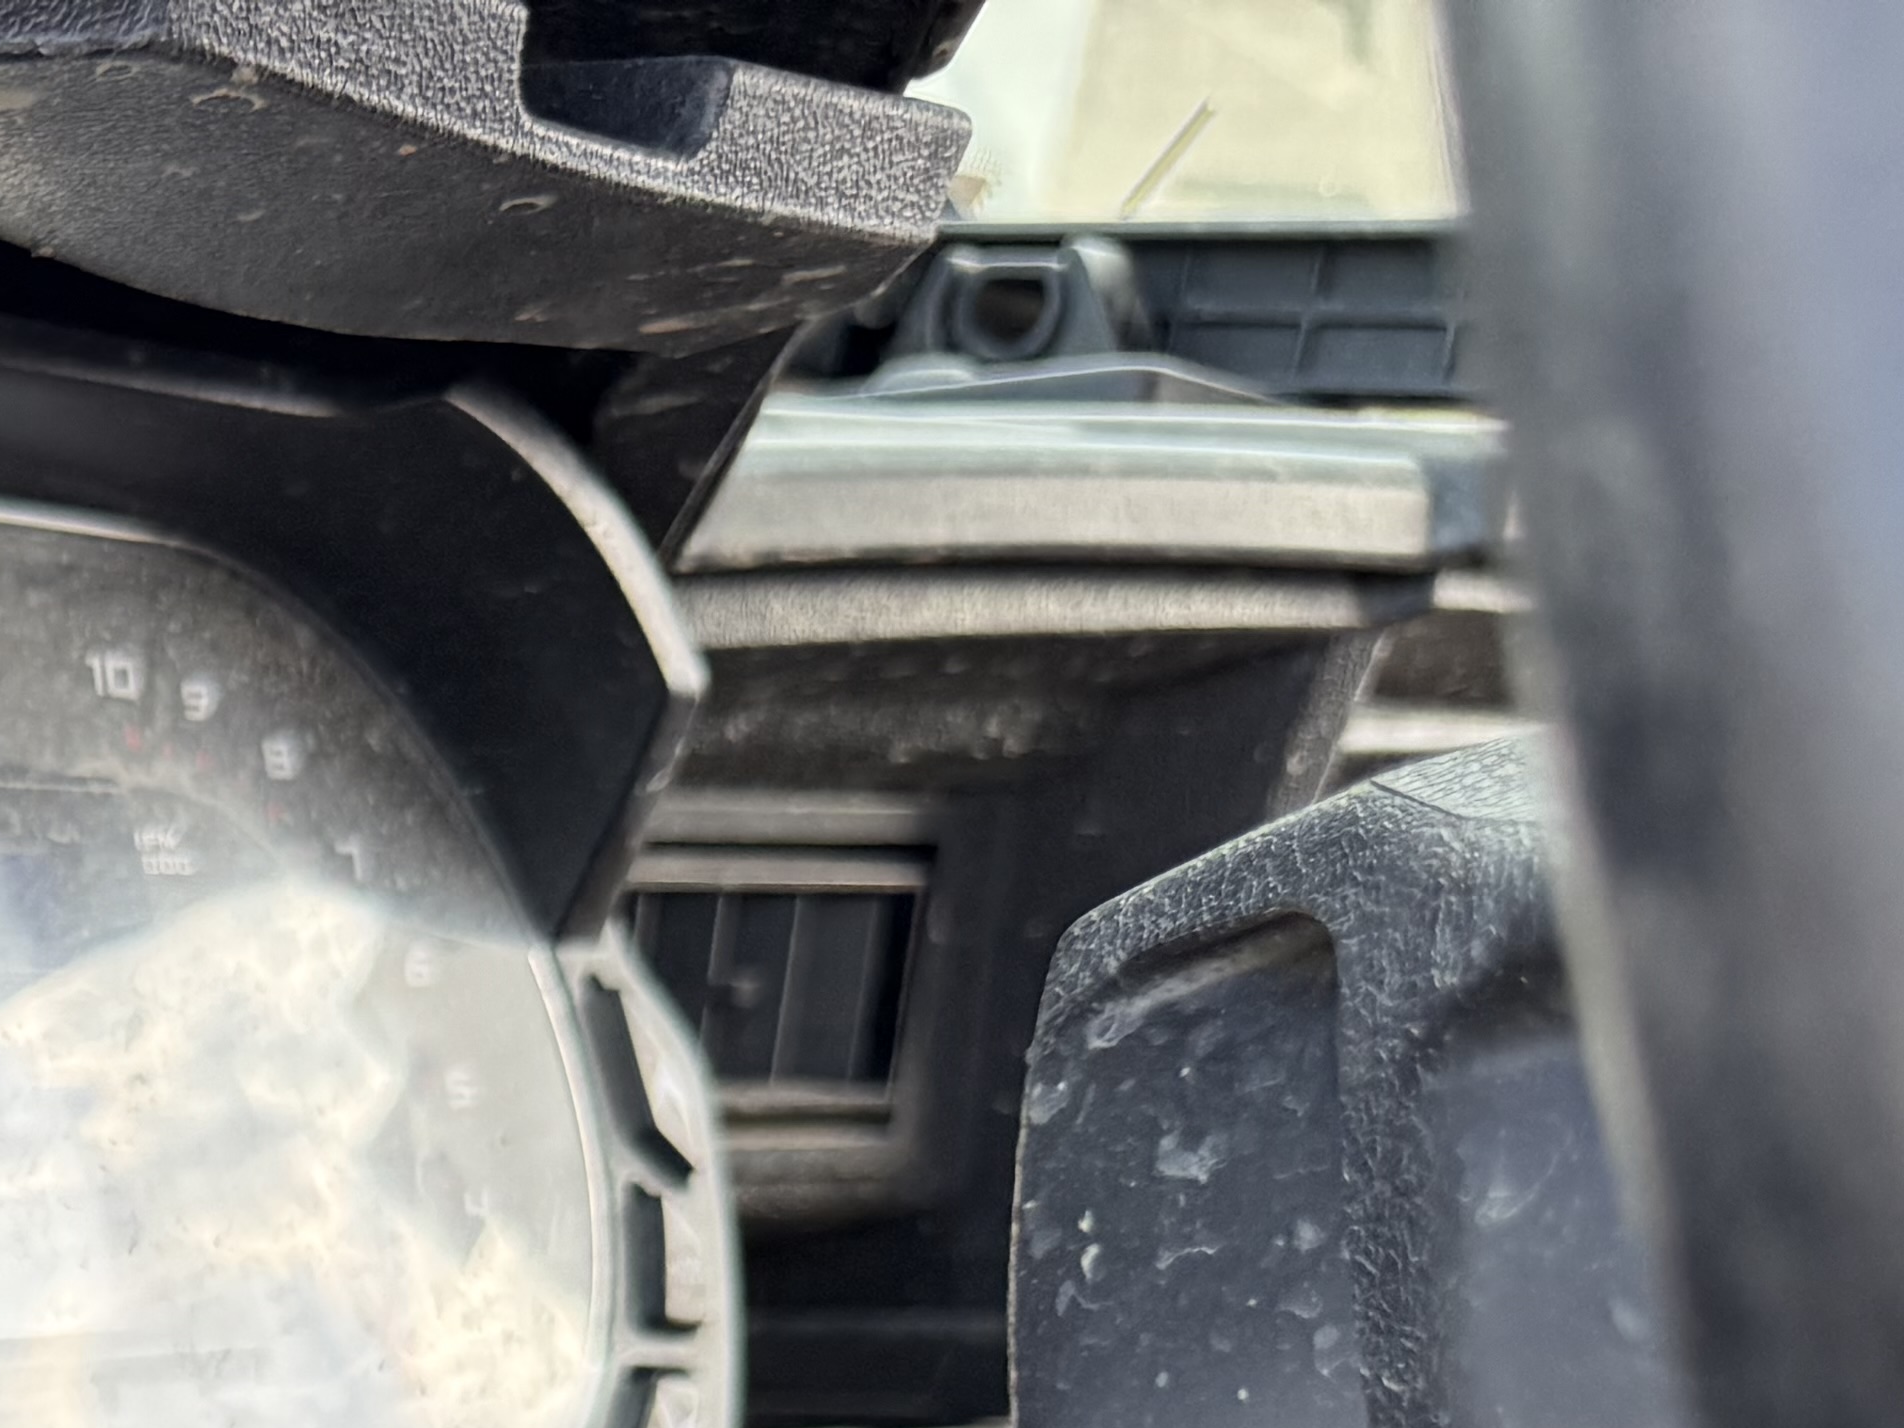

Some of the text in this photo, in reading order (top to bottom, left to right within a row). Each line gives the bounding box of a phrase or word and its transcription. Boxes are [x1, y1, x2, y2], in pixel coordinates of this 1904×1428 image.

[85, 652, 142, 700] 10
[180, 677, 212, 721] 9
[335, 837, 364, 882] 7
